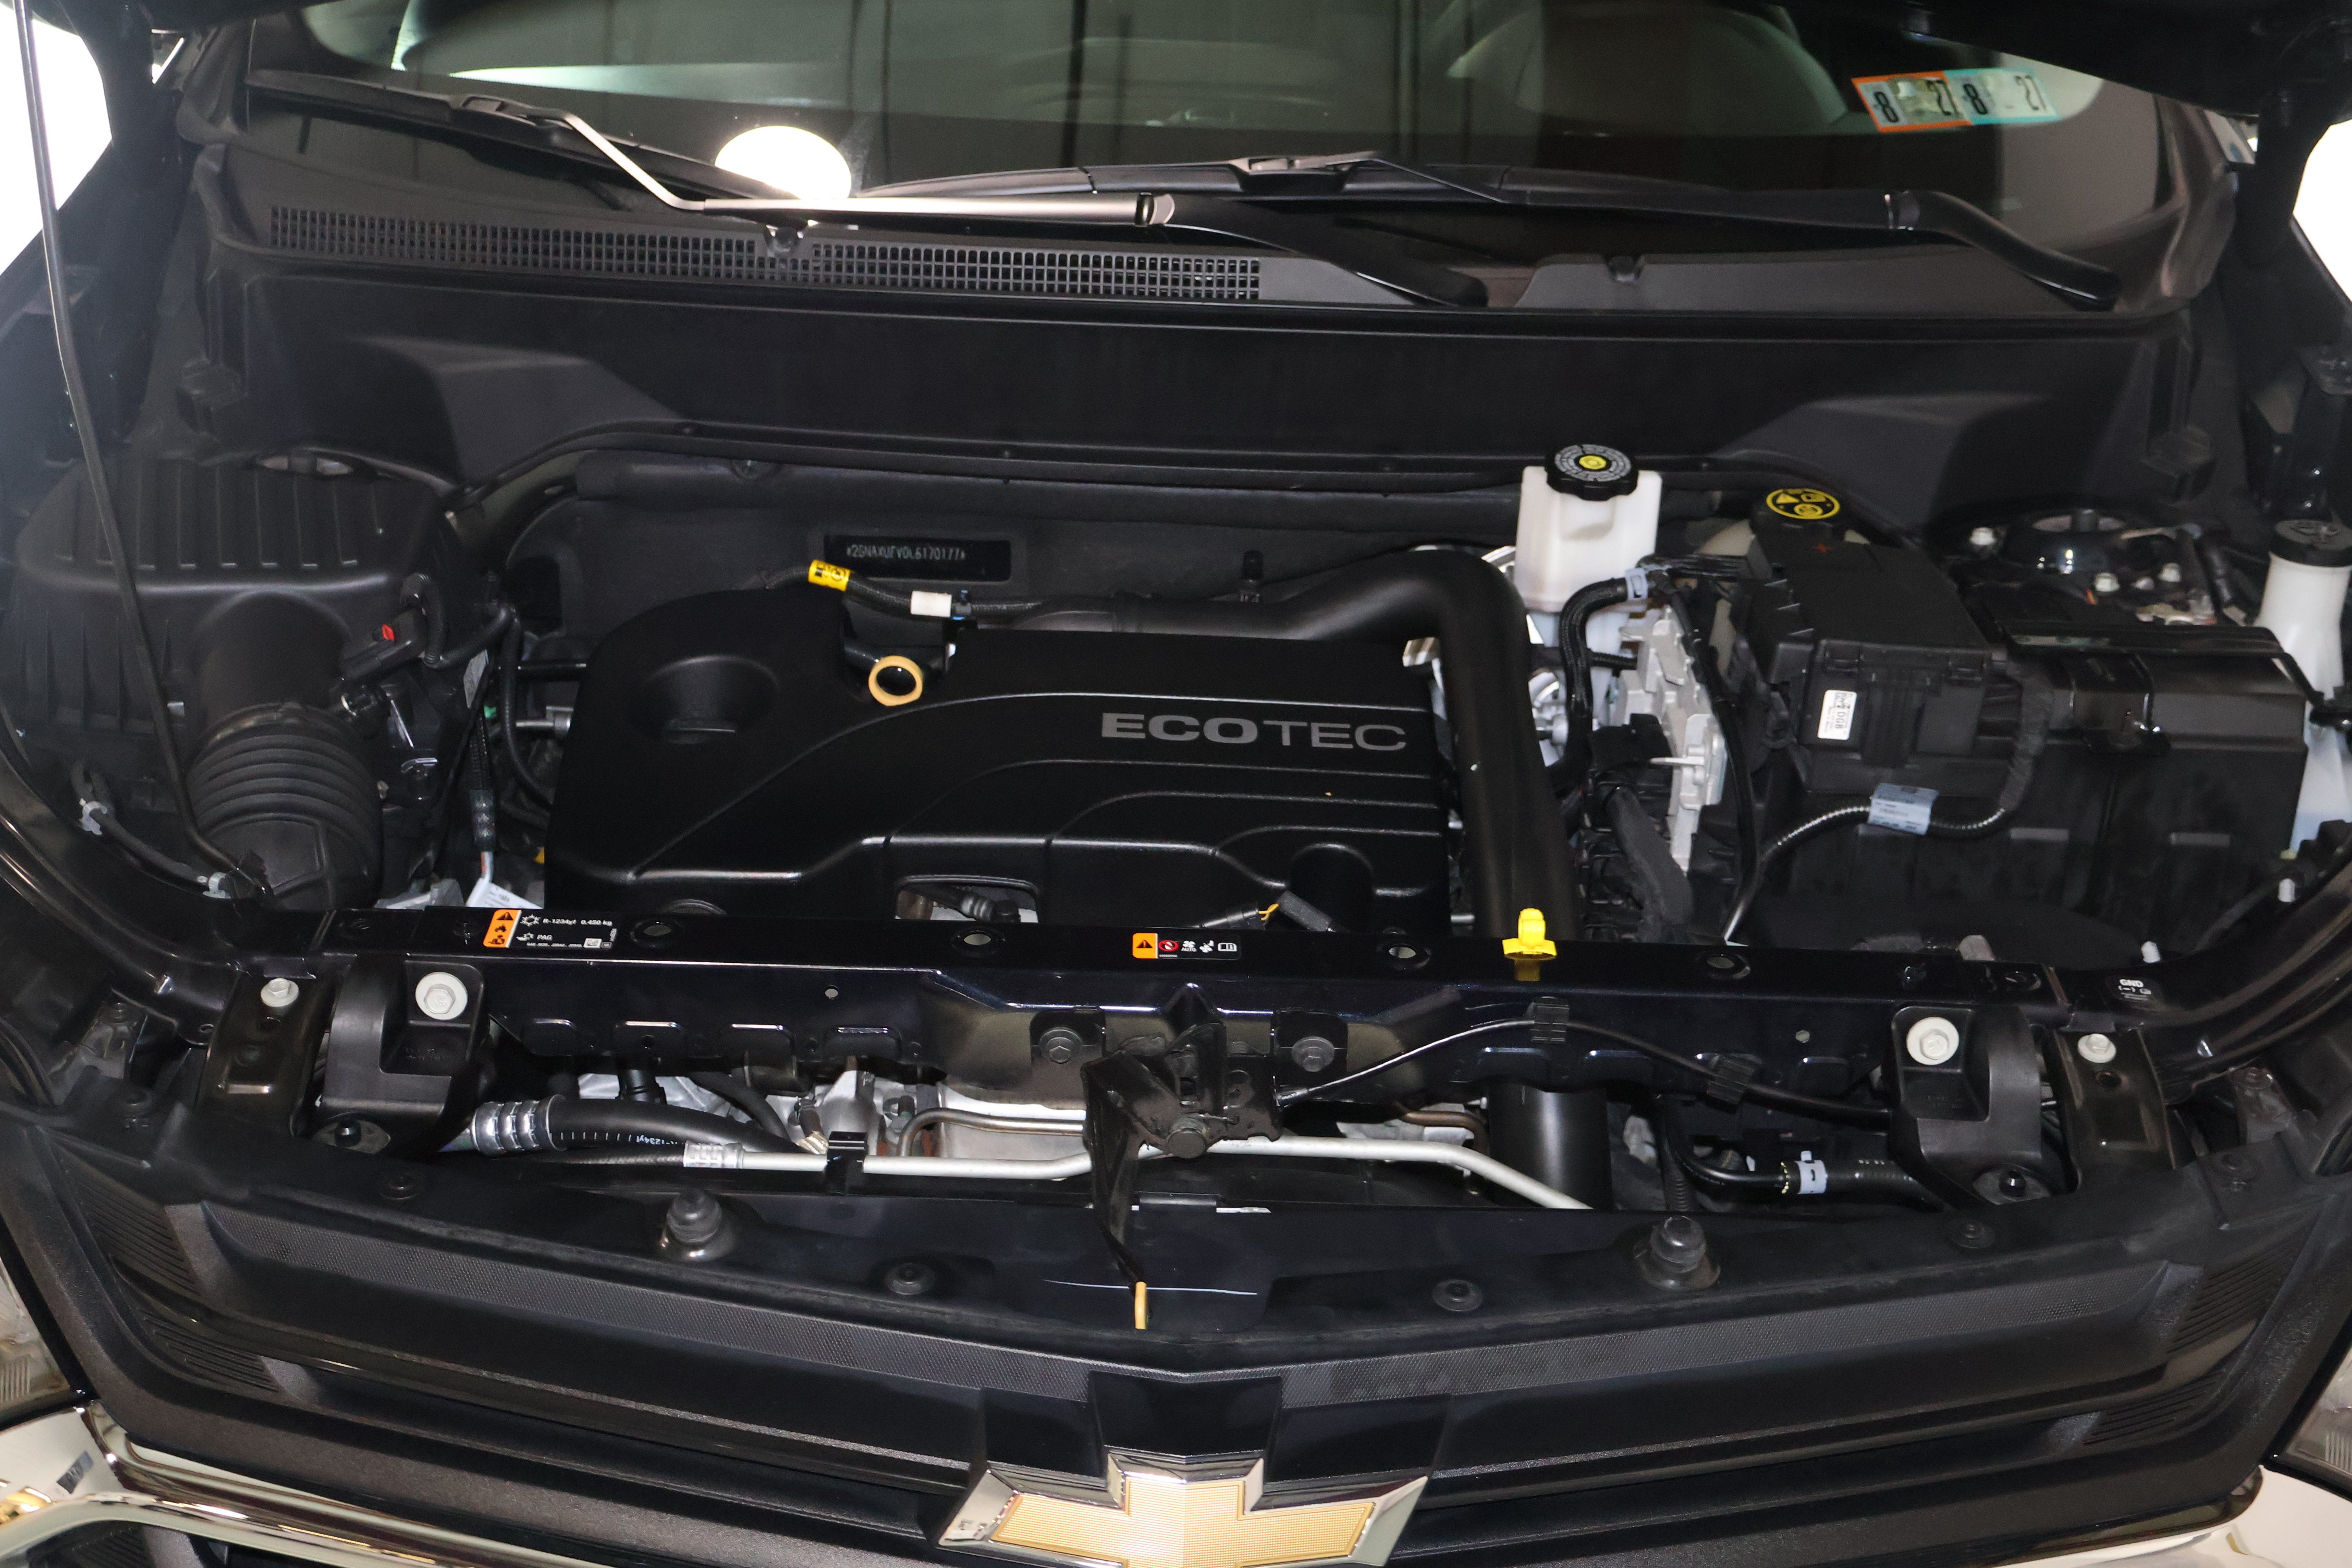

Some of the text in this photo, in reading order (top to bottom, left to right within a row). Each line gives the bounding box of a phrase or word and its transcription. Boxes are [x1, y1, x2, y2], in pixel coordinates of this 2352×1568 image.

[1873, 79, 1959, 123] 8 27
[1962, 75, 2047, 115] 8 27
[1101, 712, 1407, 751] ECOTEC
